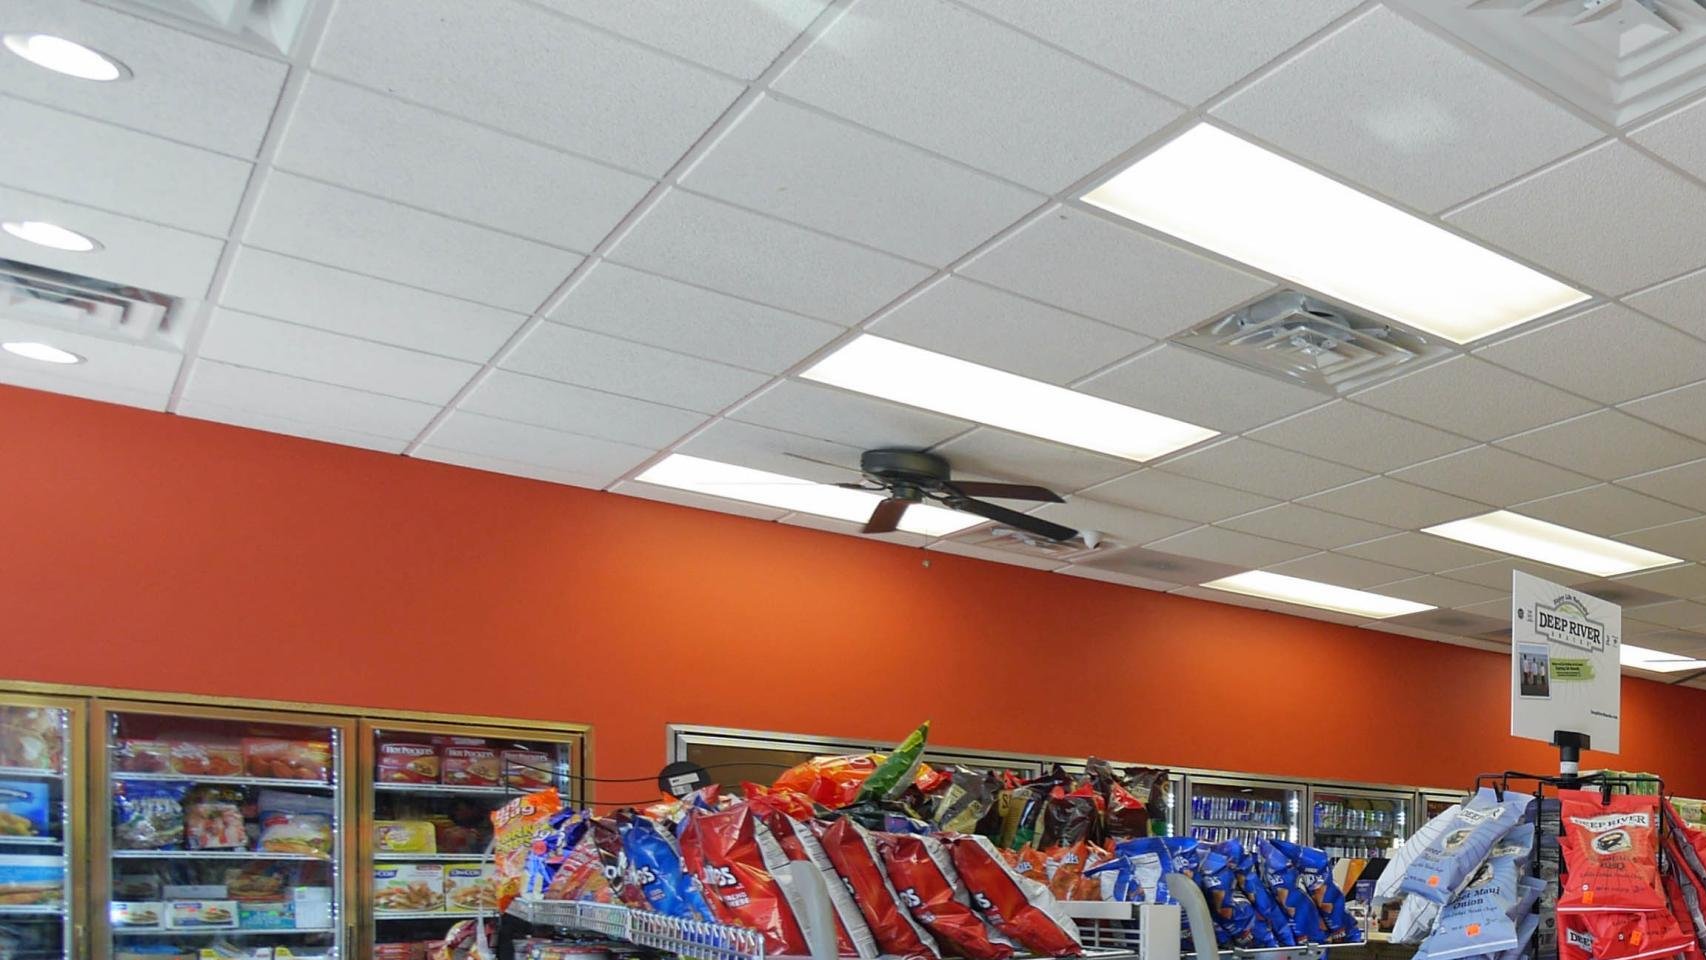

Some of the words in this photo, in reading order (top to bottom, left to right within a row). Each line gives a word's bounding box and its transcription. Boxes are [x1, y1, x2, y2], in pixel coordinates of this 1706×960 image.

[1539, 611, 1569, 632] DEEP
[1569, 620, 1601, 645] RIVER
[1607, 815, 1647, 827] RIVER
[1473, 887, 1500, 897] Maui
[1453, 898, 1484, 910] Onion
[1570, 932, 1593, 946] DEE
